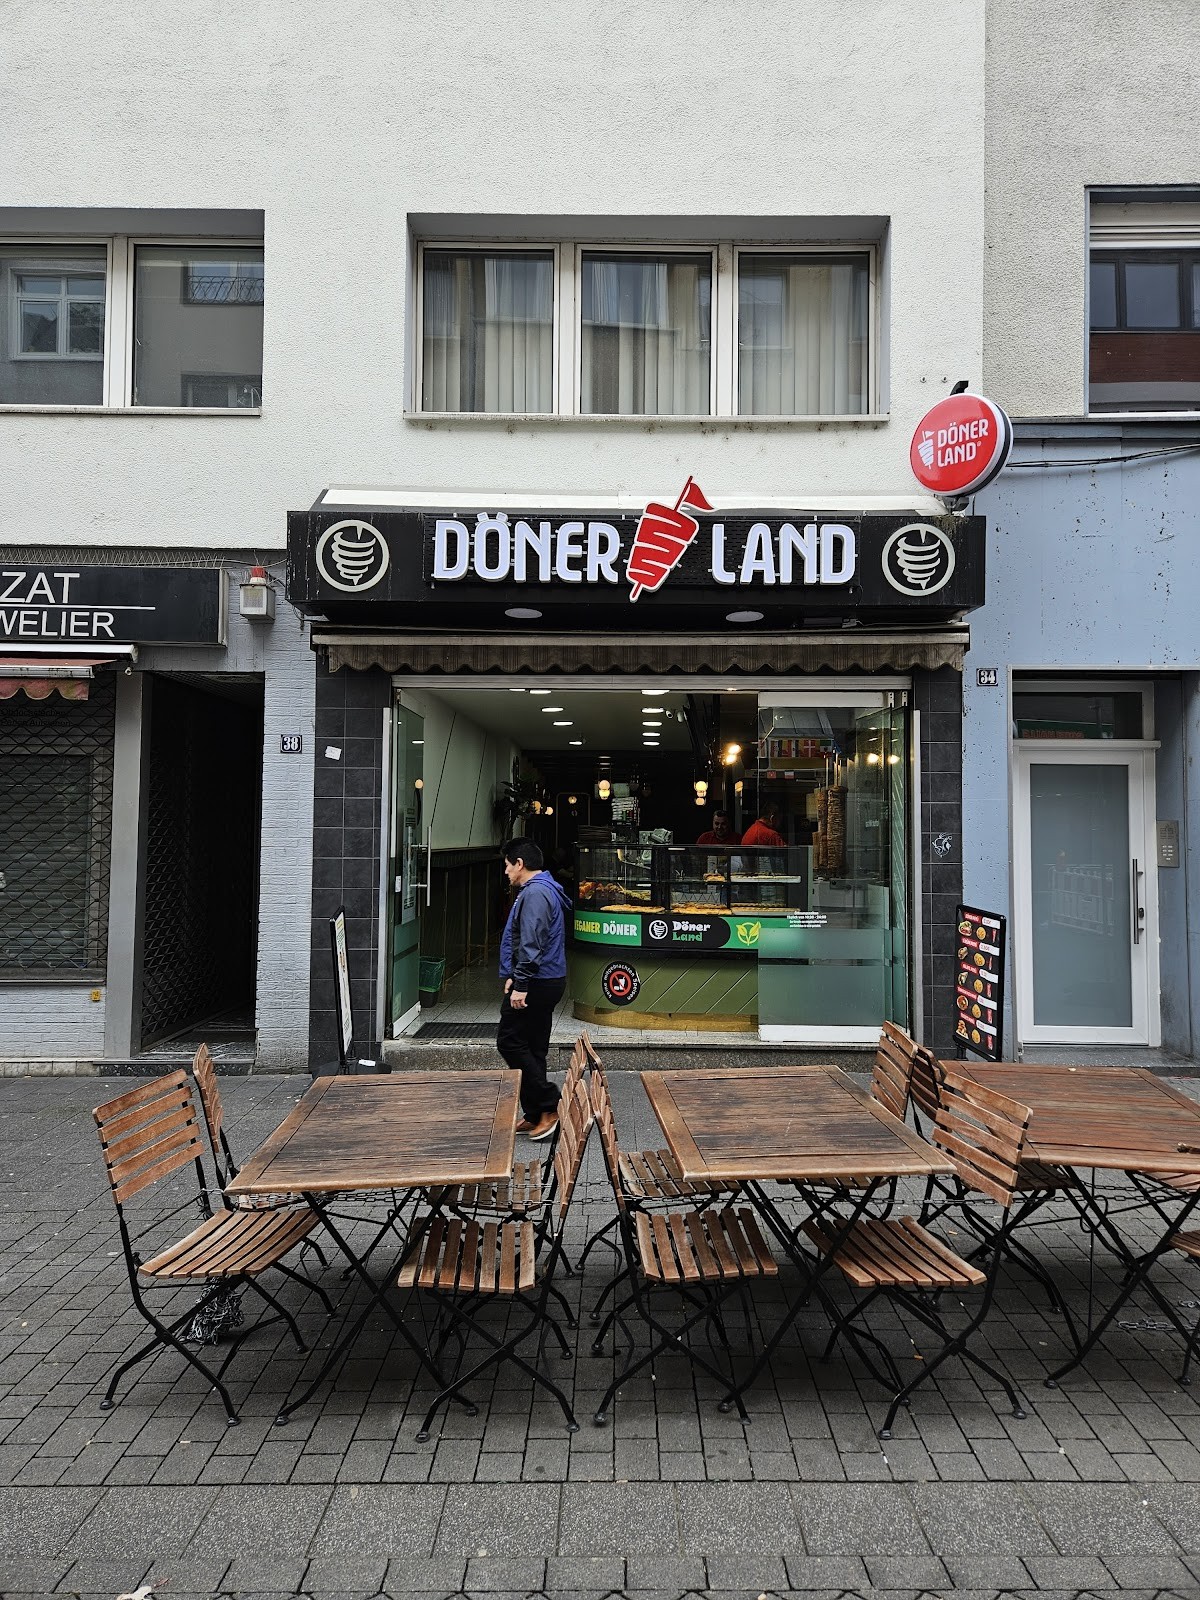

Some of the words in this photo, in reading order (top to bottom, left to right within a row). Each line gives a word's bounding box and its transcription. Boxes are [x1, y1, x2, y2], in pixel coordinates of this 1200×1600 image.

[937, 419, 988, 447] DÖNER
[434, 512, 620, 583] DÖNER
[711, 524, 856, 584] LAND
[0, 572, 80, 604] ZAT
[980, 669, 996, 684] 34
[283, 736, 299, 751] 38
[603, 920, 638, 937] DÖNER
[672, 920, 711, 932] Döner
[672, 932, 703, 942] Land
[626, 978, 638, 1001] Speisen
